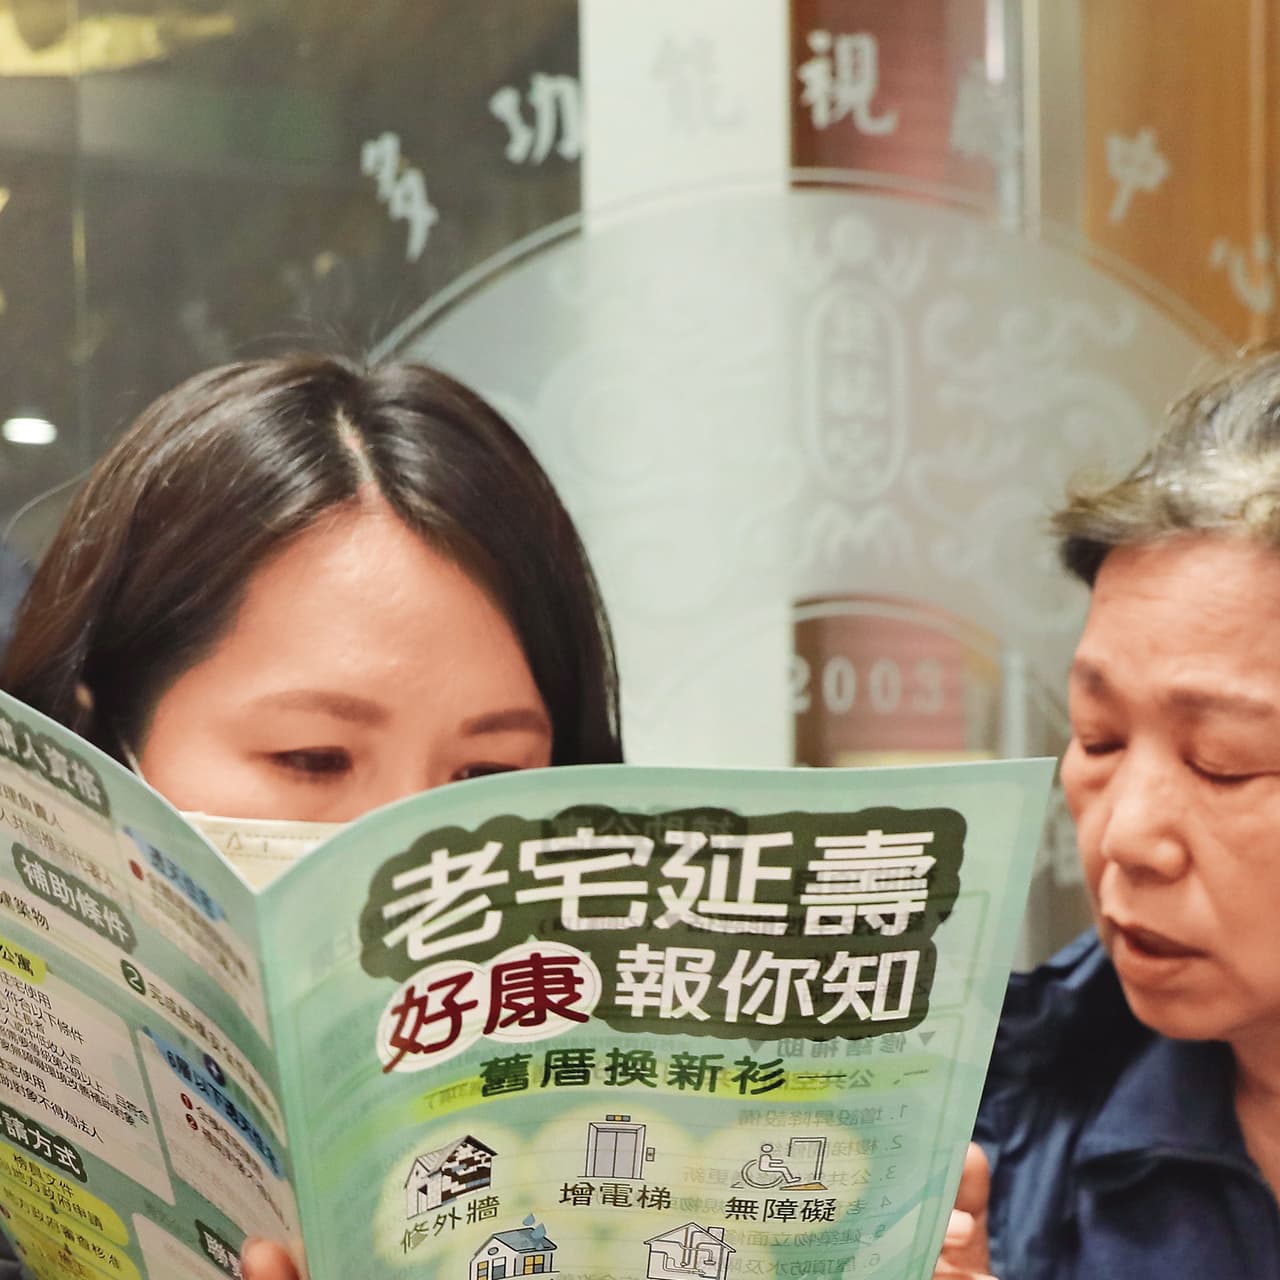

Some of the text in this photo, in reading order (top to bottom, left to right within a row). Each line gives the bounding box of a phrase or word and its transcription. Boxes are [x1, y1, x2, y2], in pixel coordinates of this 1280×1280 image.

[789, 655, 947, 715] 2003
[22, 856, 127, 943] 補助條件
[382, 826, 937, 963] 老宅延壽
[400, 1195, 500, 1256] 修外牆
[558, 1181, 672, 1212] 增電梯
[725, 1197, 838, 1223] 無障礙
